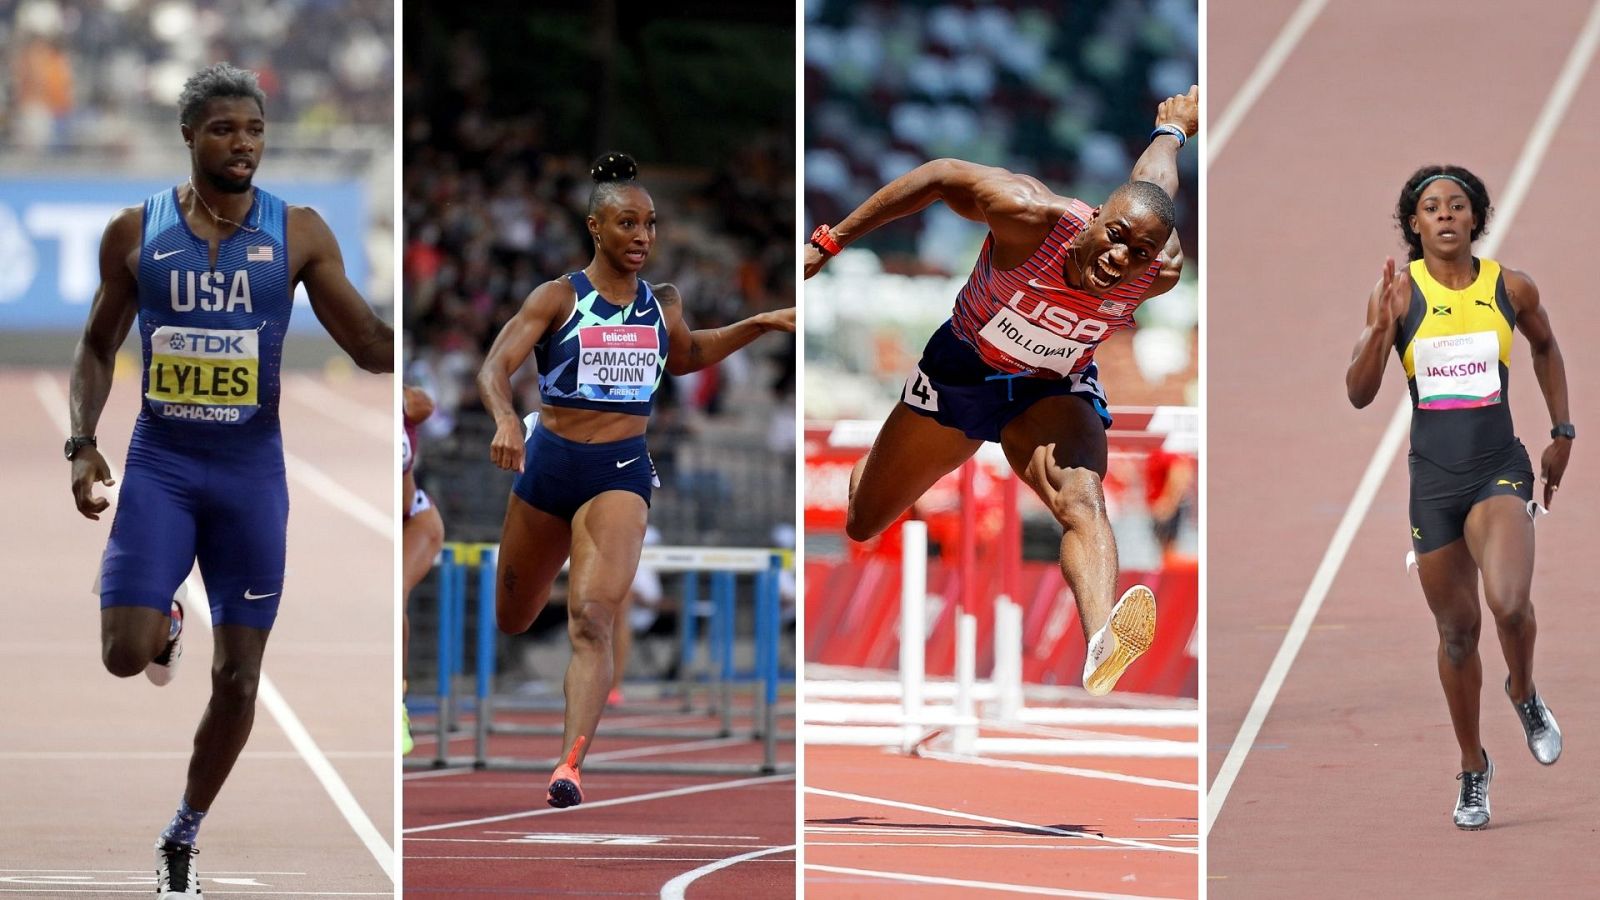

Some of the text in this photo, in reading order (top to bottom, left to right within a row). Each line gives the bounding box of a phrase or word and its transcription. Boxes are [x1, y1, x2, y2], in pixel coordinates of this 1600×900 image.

[170, 269, 253, 313] USA
[1008, 290, 1109, 342] USA
[186, 333, 244, 354] TDK
[602, 332, 638, 343] felicetti
[997, 317, 1078, 359] HOLLOWAY
[582, 351, 656, 367] CAMACHO
[593, 367, 644, 384] -QUINN
[1426, 361, 1487, 377] JACKSON
[156, 363, 249, 397] LYLES
[912, 371, 931, 405] 4
[609, 388, 640, 396] FIRENZE
[163, 404, 240, 421] DOHA2019
